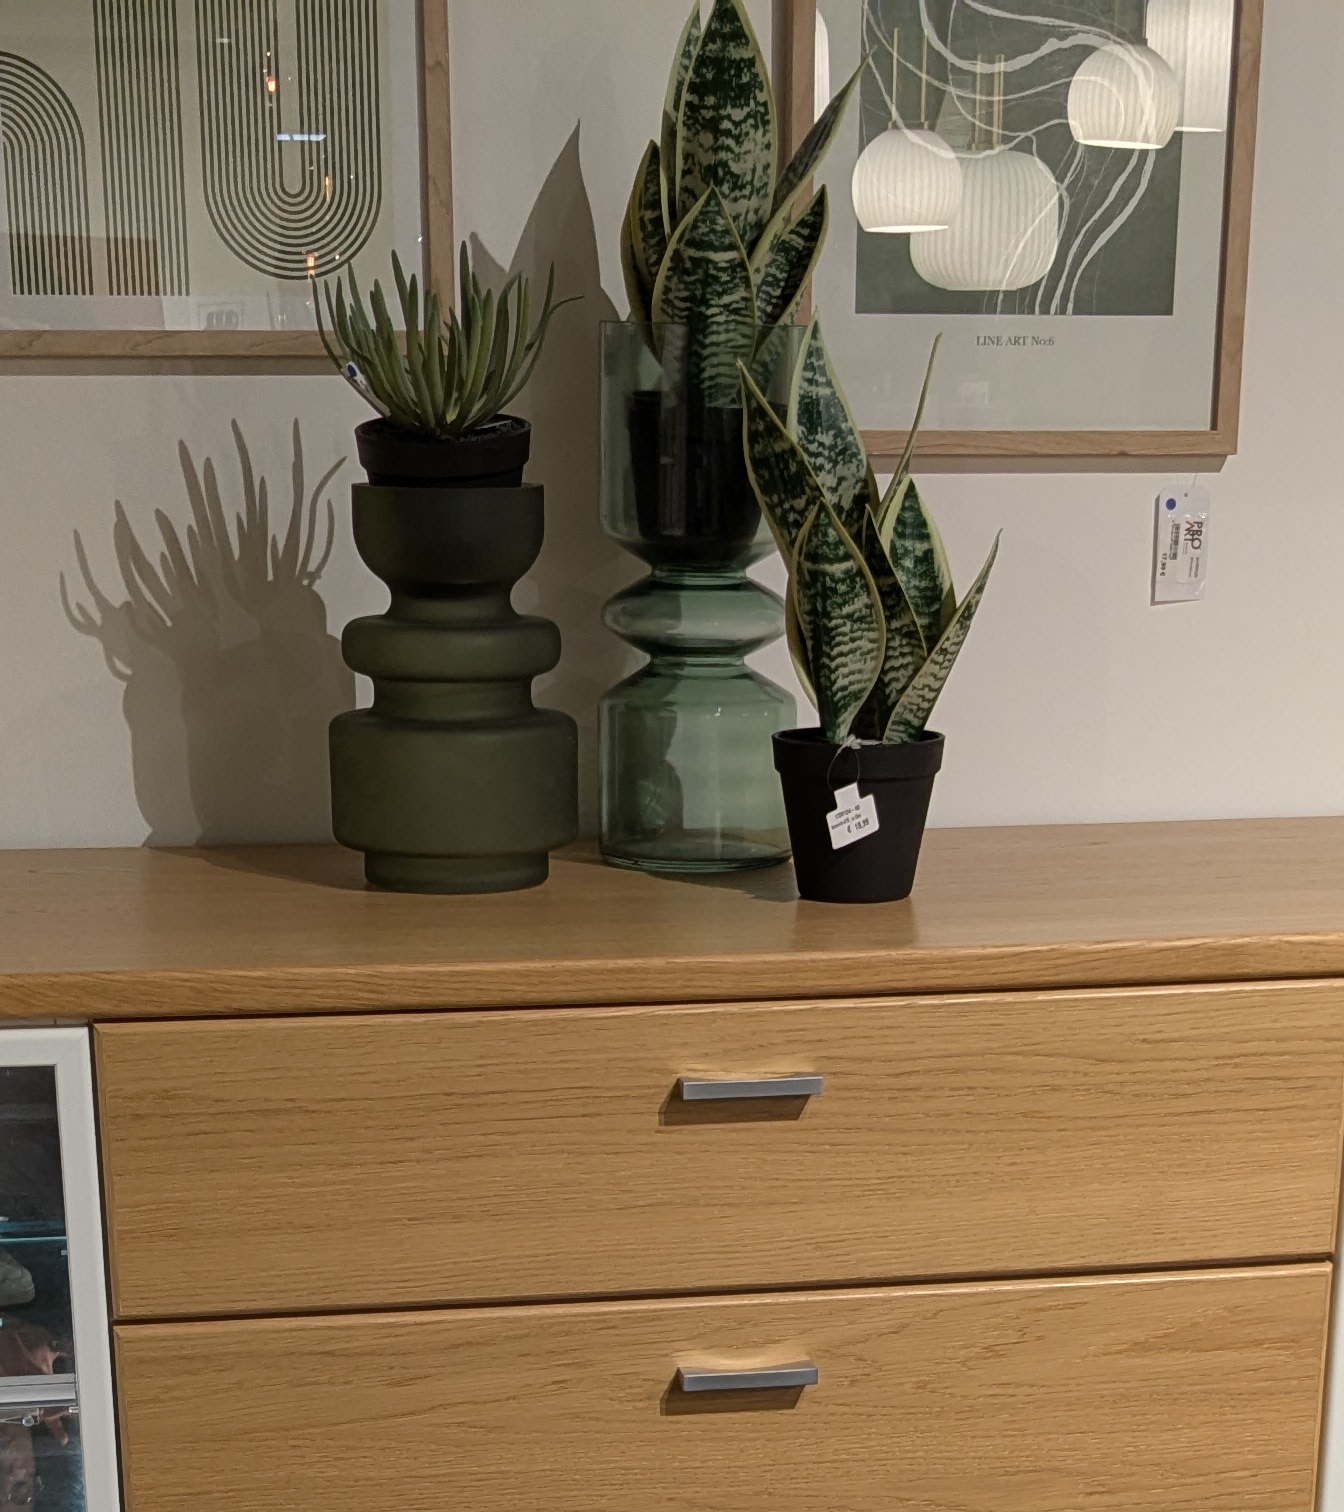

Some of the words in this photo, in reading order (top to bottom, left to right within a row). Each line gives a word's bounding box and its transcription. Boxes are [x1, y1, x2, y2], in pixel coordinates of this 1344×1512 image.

[976, 335, 1003, 346] LINE
[1005, 335, 1028, 346] ART
[1183, 520, 1196, 542] ART
[1191, 521, 1204, 550] PRO
